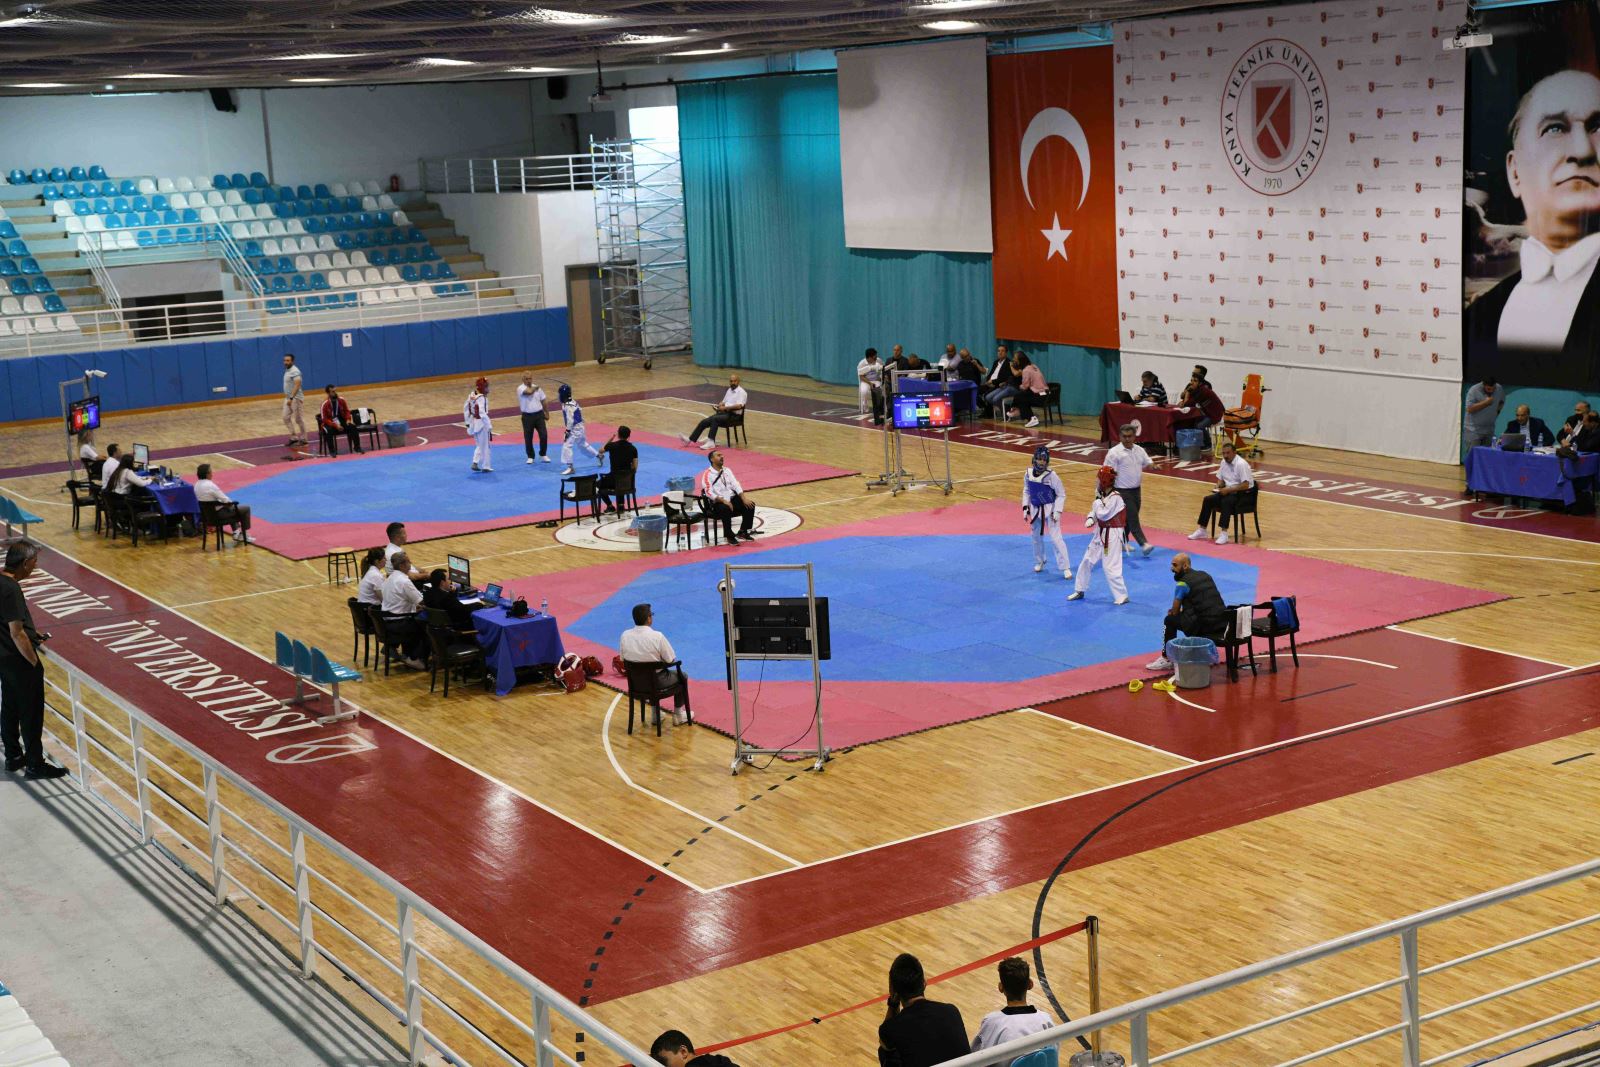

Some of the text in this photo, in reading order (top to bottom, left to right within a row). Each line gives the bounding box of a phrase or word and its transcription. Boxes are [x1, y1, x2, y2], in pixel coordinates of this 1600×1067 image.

[1225, 46, 1325, 180] KONYA TEKNİK ÜNİVERSİTESİ
[1263, 177, 1283, 189] 1970
[905, 408, 912, 418] 0
[934, 406, 941, 417] 4
